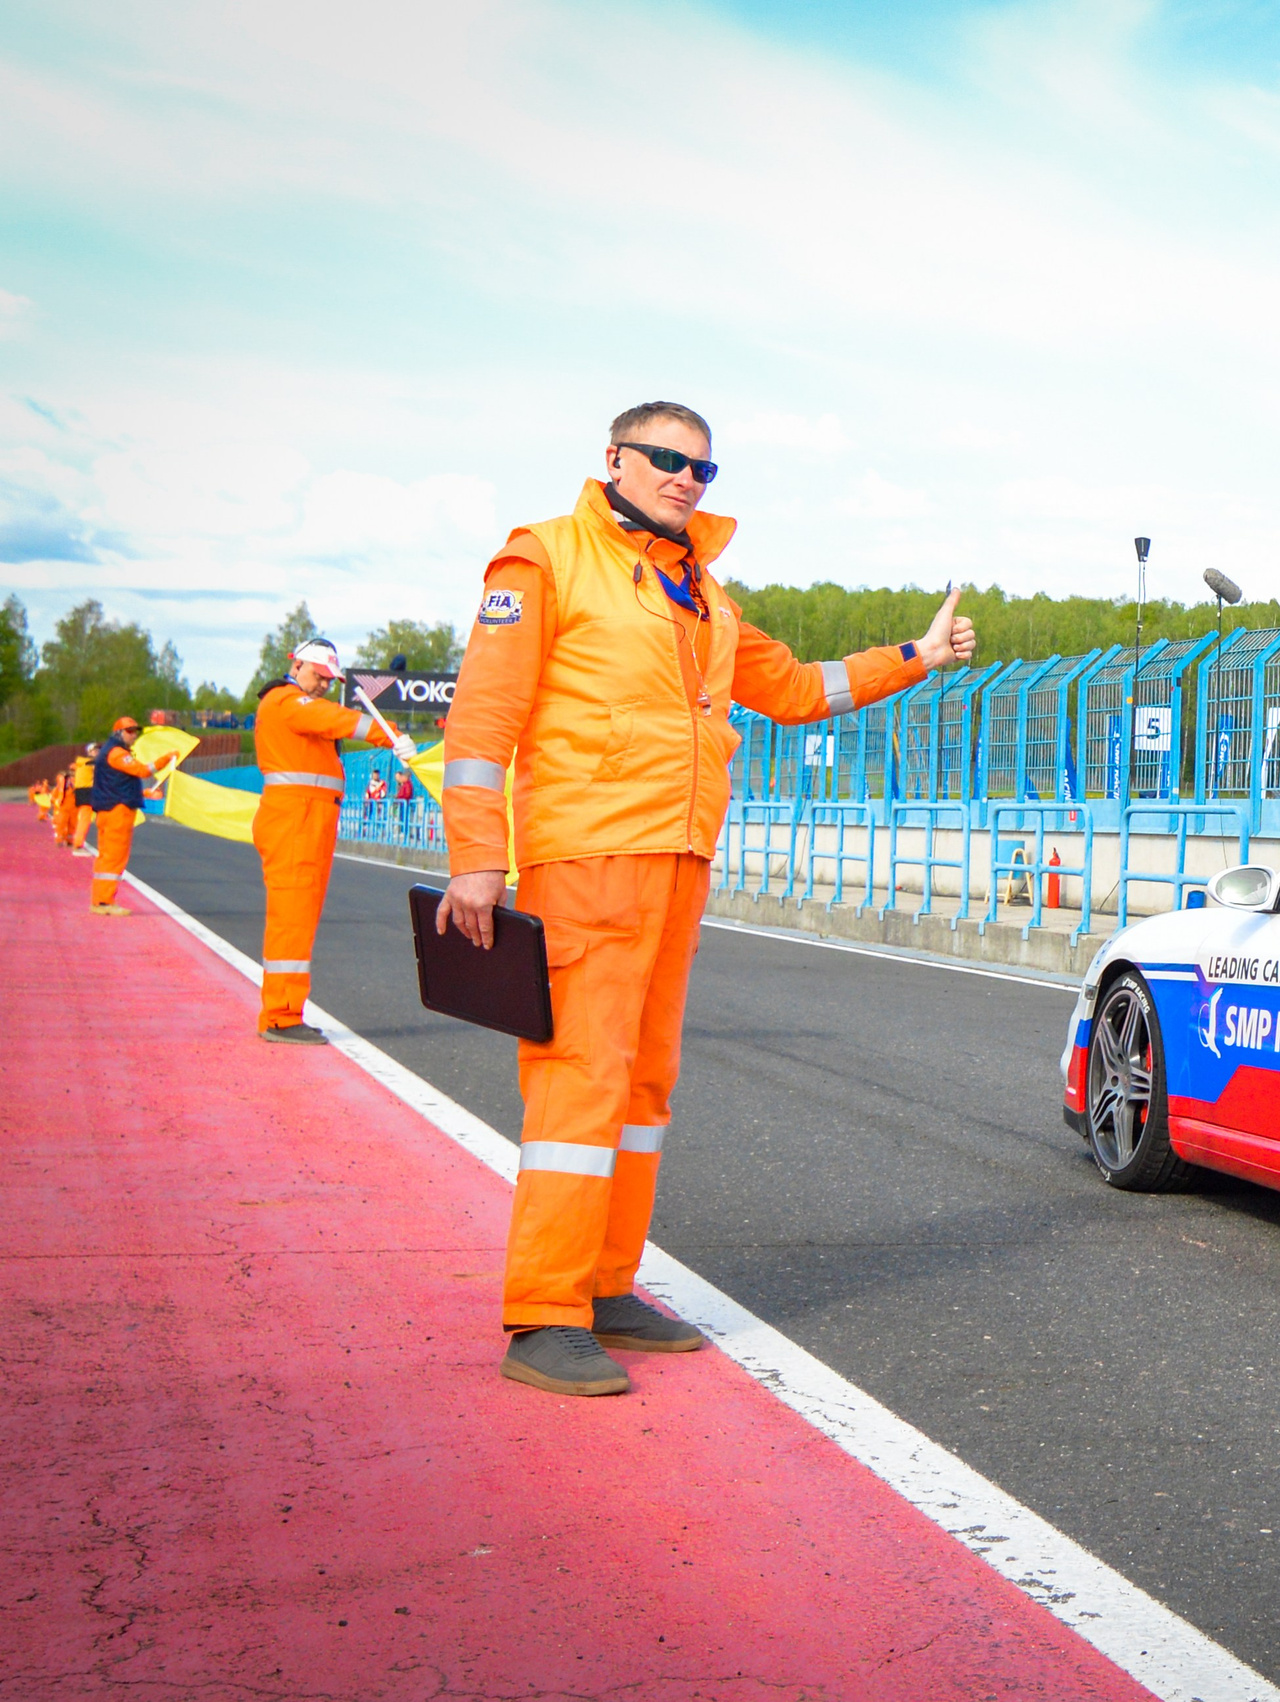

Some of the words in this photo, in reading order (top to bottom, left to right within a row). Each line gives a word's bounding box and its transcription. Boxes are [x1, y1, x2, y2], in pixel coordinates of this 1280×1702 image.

[1146, 717, 1161, 740] 5
[1208, 956, 1260, 981] LEADING
[1134, 986, 1151, 1014] RACING
[1224, 1005, 1272, 1050] SMP
